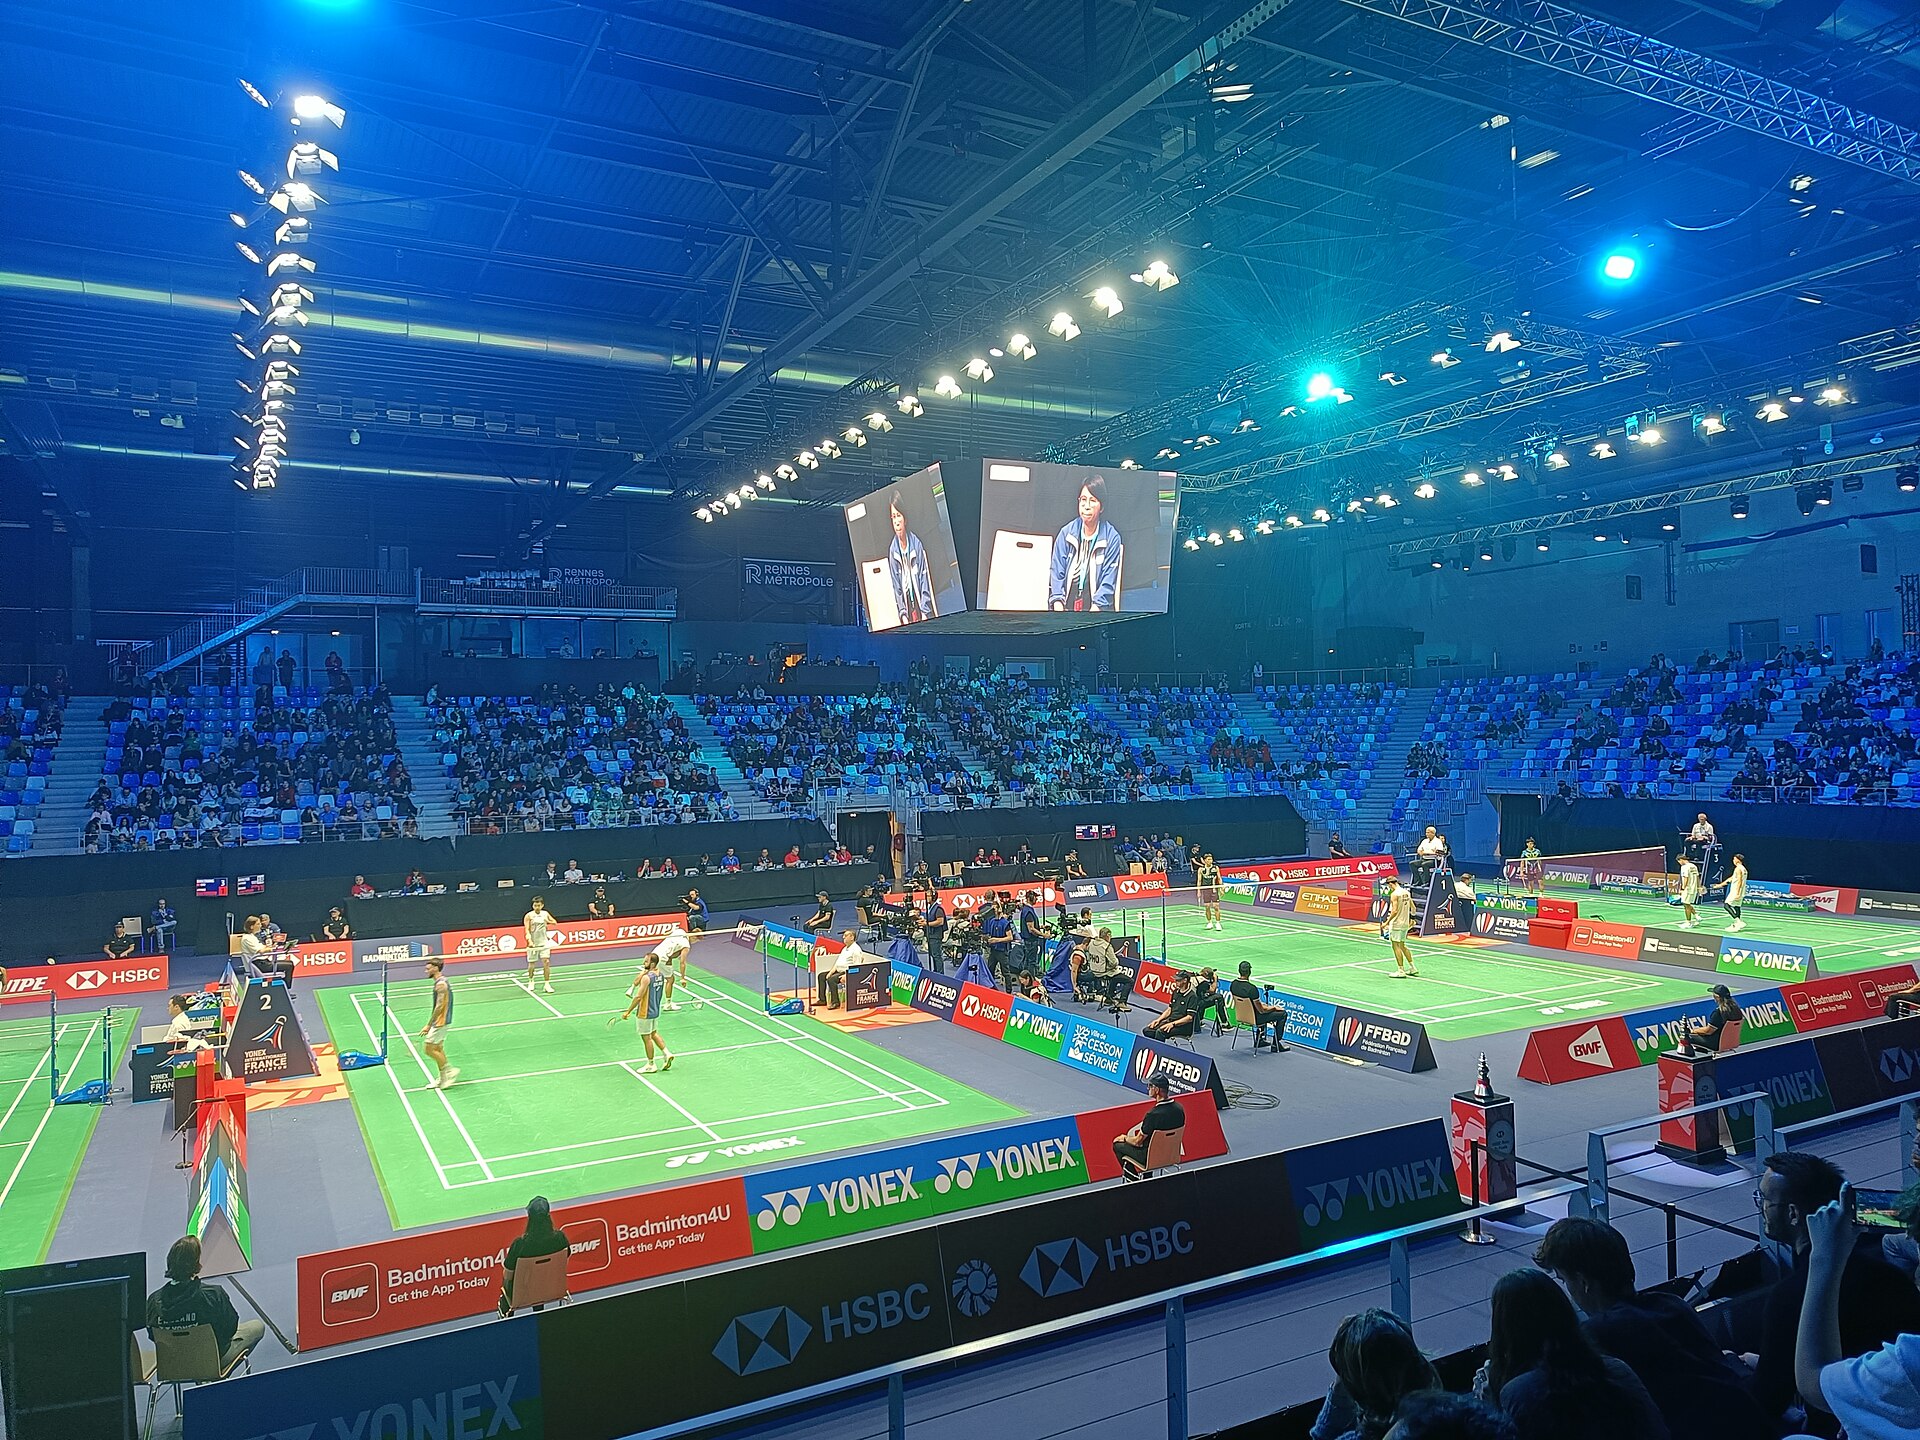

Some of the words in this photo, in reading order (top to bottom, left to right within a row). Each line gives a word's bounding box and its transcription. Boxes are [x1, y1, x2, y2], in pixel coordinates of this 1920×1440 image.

[1377, 863, 1394, 871] HSBC
[1714, 853, 1719, 863] 3
[1287, 868, 1310, 879] HSBC
[1561, 871, 1589, 884] YONEX
[1140, 880, 1166, 890] HSBC
[1233, 884, 1255, 897] YONEX
[1441, 879, 1446, 890] 1
[1500, 898, 1528, 912] YONEX
[461, 934, 498, 948] ouest
[568, 929, 606, 943] HSBC
[303, 951, 347, 966] HSBC
[1752, 951, 1803, 972] YONEX
[112, 968, 161, 984] HSBC
[892, 969, 916, 992] YONEX
[931, 983, 957, 1000] FFBaD
[259, 994, 272, 1011] 2
[979, 1002, 1006, 1023] HSBC
[1741, 1001, 1789, 1030] YONEX
[1029, 1013, 1064, 1043] YONEX
[1284, 1021, 1321, 1041] ÉVIGNÉ
[1364, 1023, 1411, 1046] FFBaD
[1087, 1038, 1123, 1060] CESSON
[1573, 1040, 1602, 1057] BWF
[244, 1057, 288, 1071] FRANCE
[1082, 1051, 1119, 1074] SÉVIGNÉ
[1158, 1056, 1201, 1083] FFBaD
[150, 1081, 174, 1092] FRAN
[1759, 1069, 1824, 1110] YONEX
[714, 1135, 806, 1158] YONEX
[985, 1136, 1077, 1183] YONEX
[817, 1166, 920, 1217] YONEX
[1356, 1156, 1449, 1212] YONEX
[616, 1204, 731, 1242] Badminton4U
[569, 1238, 602, 1255] BWF
[617, 1245, 638, 1257] Get
[639, 1242, 653, 1253] the
[654, 1238, 675, 1250] App
[676, 1232, 705, 1246] Today
[1105, 1220, 1194, 1272] HSBC
[387, 1247, 511, 1288] Badminton4
[330, 1284, 370, 1304] BWF
[388, 1292, 409, 1305] Get
[410, 1289, 429, 1300] the
[431, 1284, 455, 1297] App
[457, 1276, 490, 1292] Today
[820, 1282, 931, 1343] HSBC
[330, 1374, 523, 1440] YONEX
